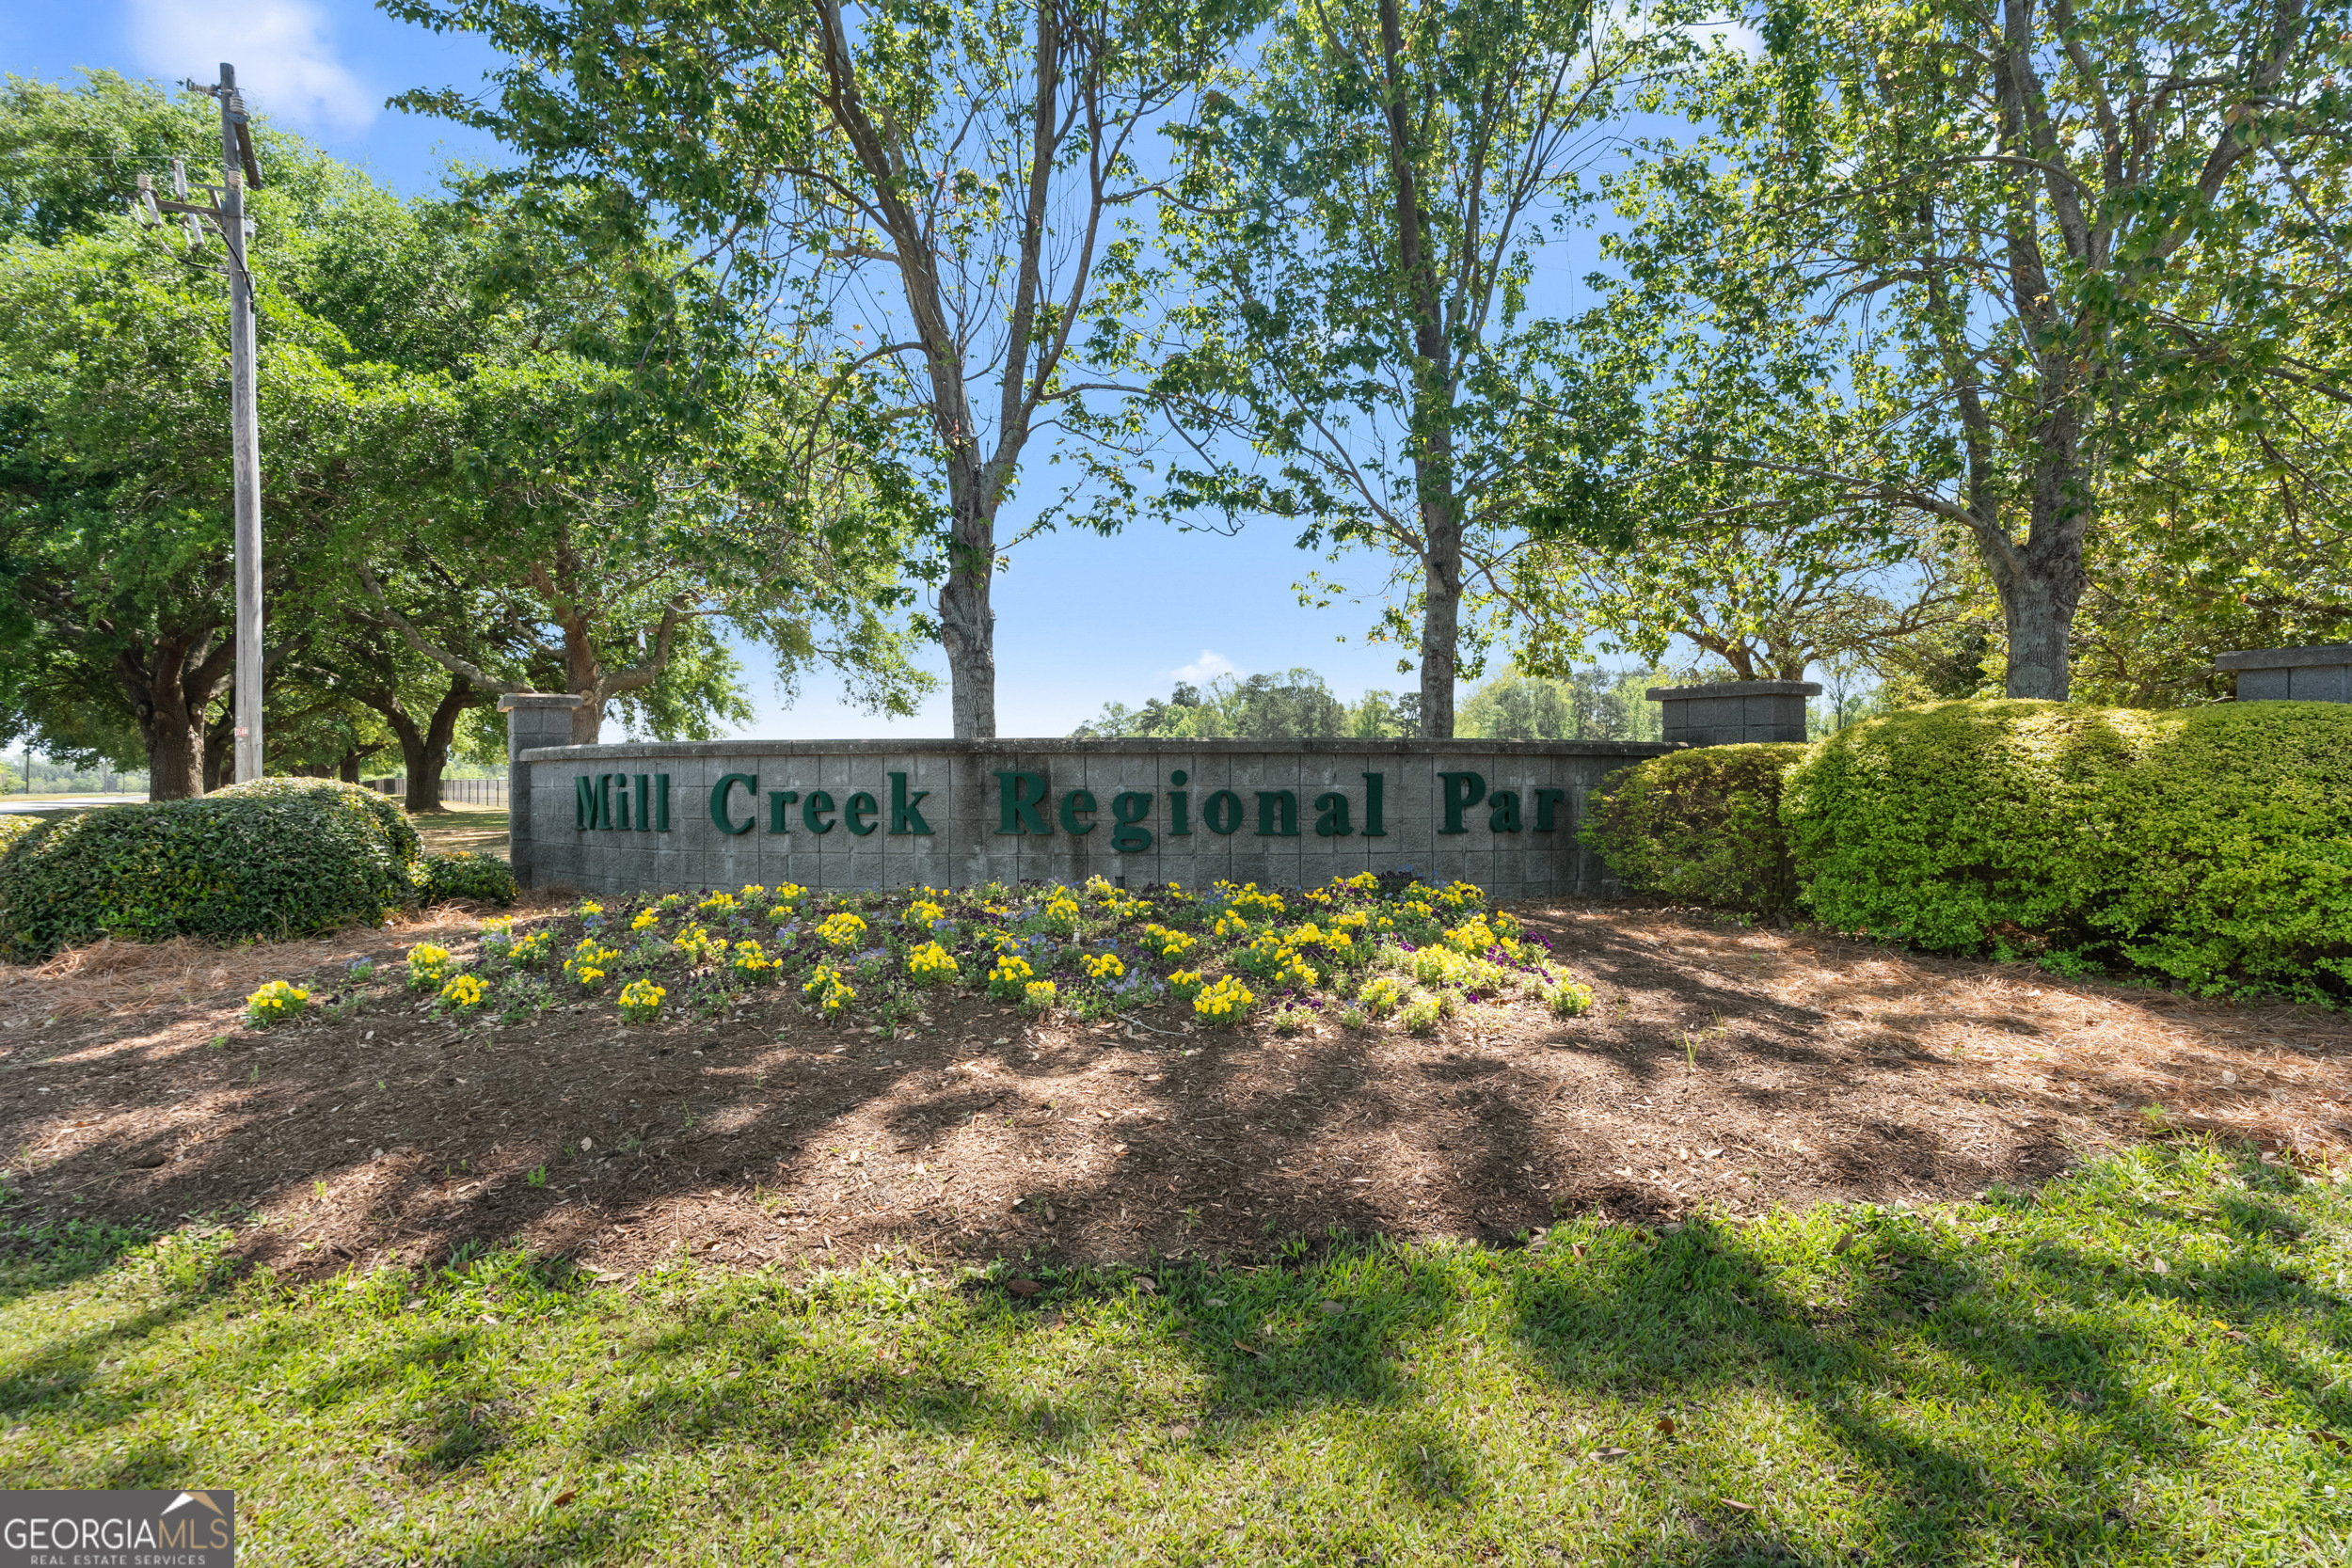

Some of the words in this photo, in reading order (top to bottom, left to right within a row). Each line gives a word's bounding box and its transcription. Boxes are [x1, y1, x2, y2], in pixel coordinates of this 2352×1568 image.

[574, 772, 671, 832] Mill
[709, 771, 935, 836] Creek
[993, 769, 1388, 852] Regional
[1438, 771, 1565, 834] Par
